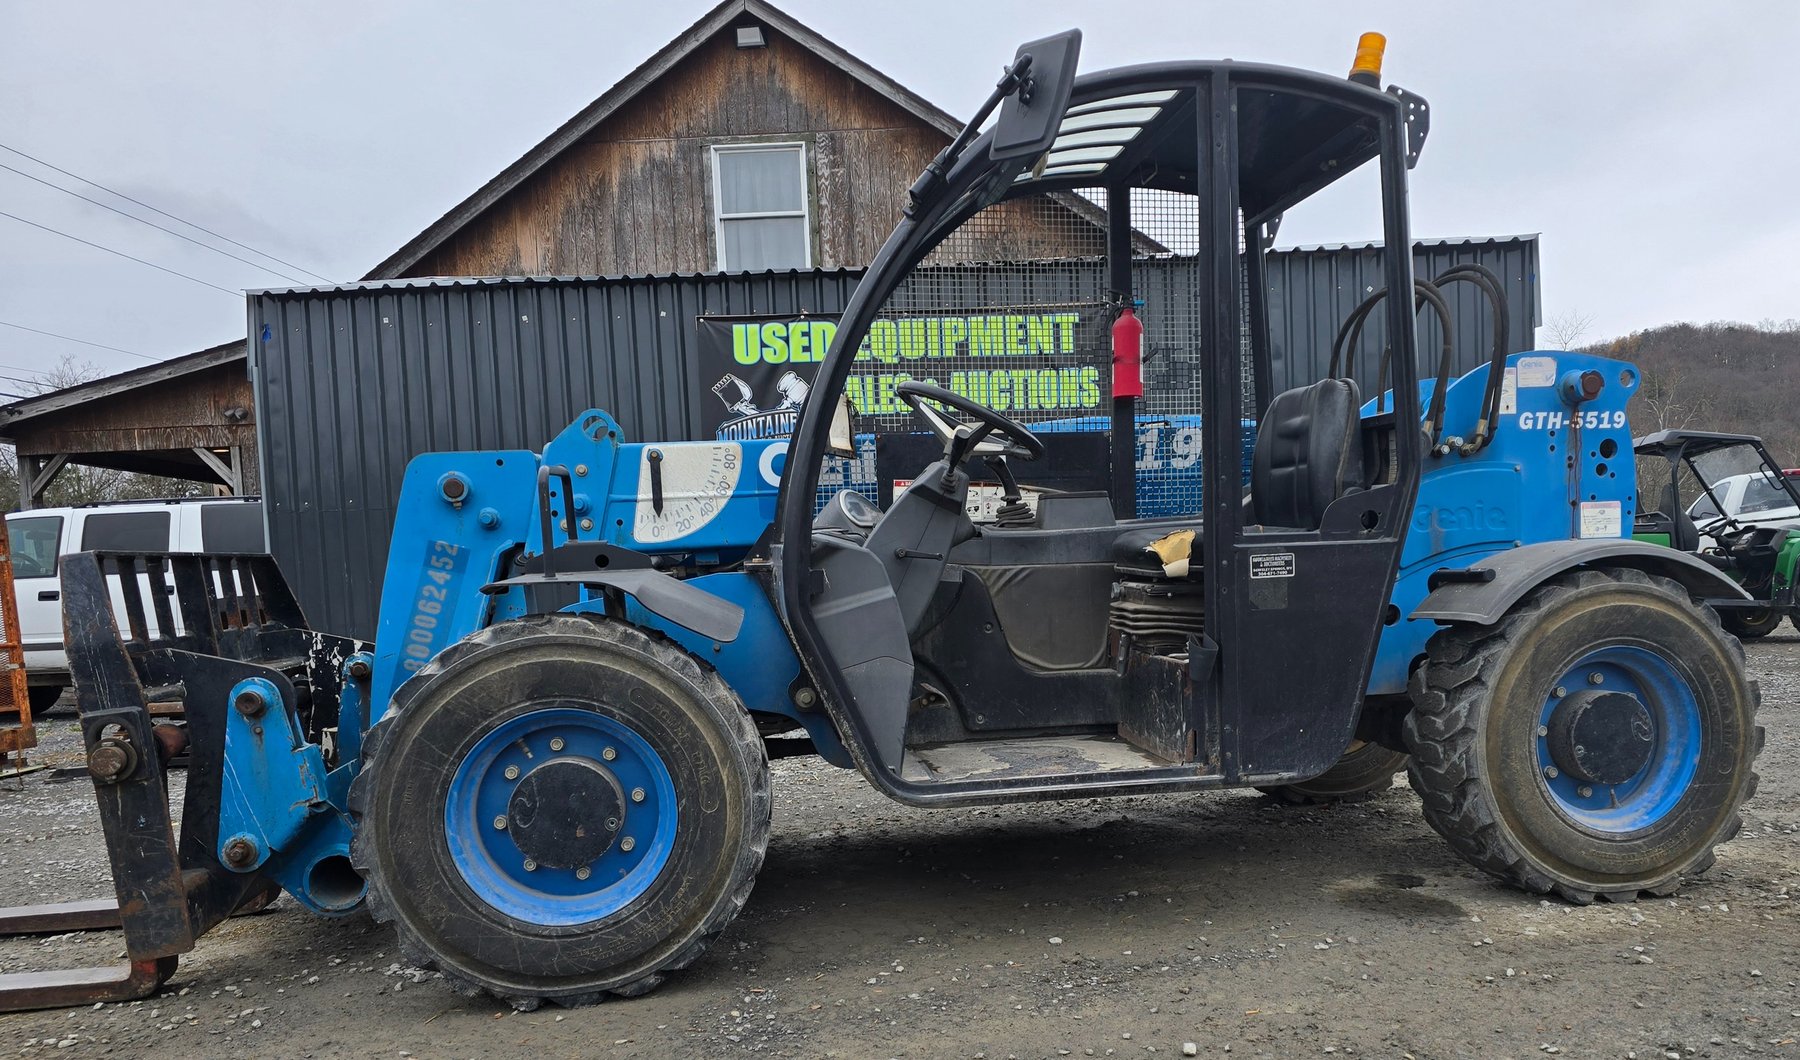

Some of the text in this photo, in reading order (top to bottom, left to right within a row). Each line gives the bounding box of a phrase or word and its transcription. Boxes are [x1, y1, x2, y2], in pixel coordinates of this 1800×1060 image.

[732, 321, 838, 365] USED
[845, 372, 914, 415] ALES
[948, 366, 1100, 411] AUCTIONS
[1519, 411, 1626, 430] GTH-5519
[403, 540, 459, 672] 800062452
